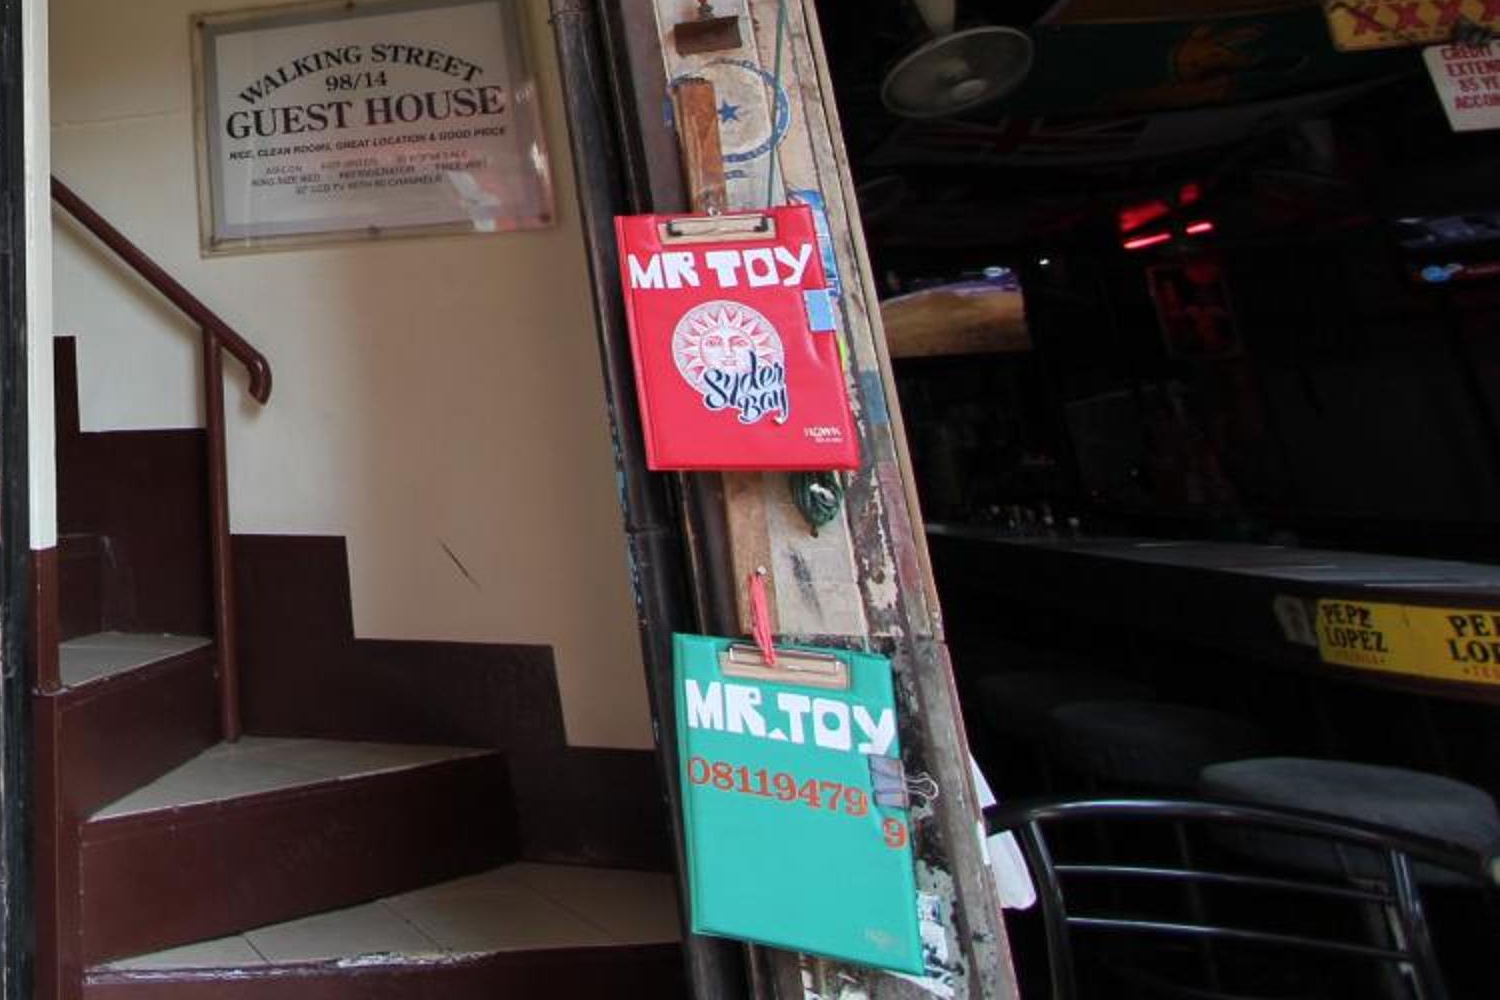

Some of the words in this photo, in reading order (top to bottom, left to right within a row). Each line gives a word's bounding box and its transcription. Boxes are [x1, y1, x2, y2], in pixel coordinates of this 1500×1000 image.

[239, 46, 362, 107] WALKING
[371, 43, 484, 84] STREET
[325, 70, 389, 92] 98/14
[226, 100, 353, 141] GUEST
[366, 84, 506, 127] HOUSE
[257, 145, 292, 158] CLEAN
[373, 132, 427, 148] LOCATION
[626, 250, 702, 290] MR
[704, 243, 814, 289] TOY
[1321, 603, 1374, 630] PEPE
[1323, 626, 1390, 653] LOPEZ
